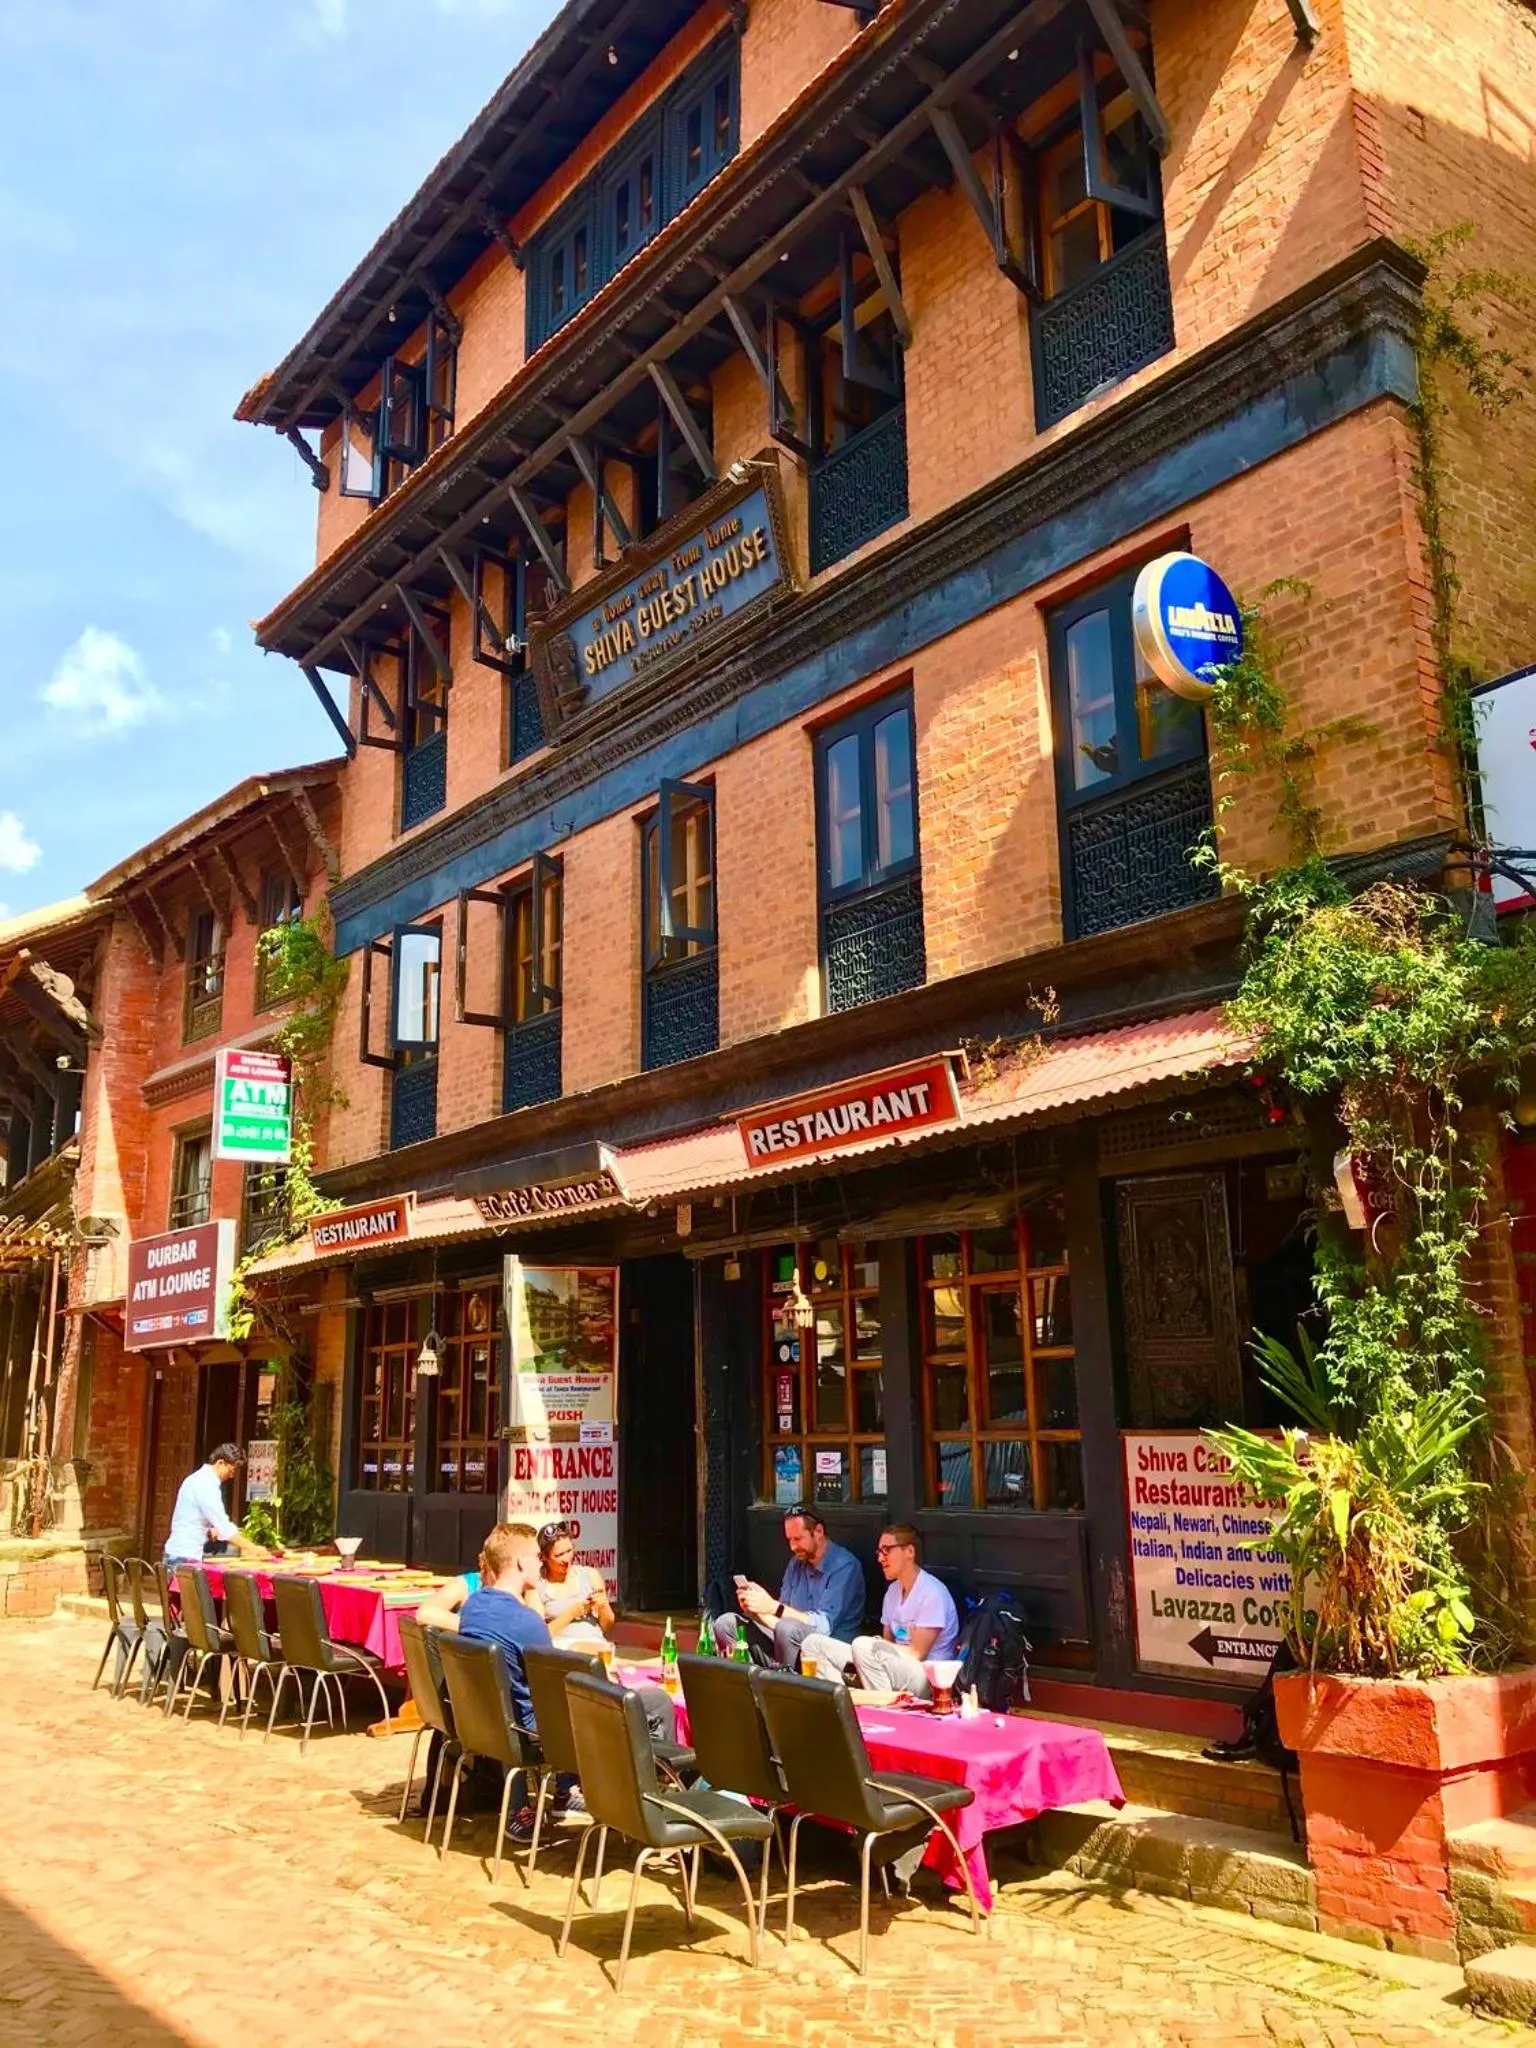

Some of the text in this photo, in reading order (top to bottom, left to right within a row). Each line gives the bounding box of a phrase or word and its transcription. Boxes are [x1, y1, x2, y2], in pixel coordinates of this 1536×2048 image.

[603, 594, 633, 623] home
[704, 517, 741, 550] home
[583, 618, 637, 674] SHIVA
[637, 575, 698, 638] GUEST
[699, 526, 767, 599] HOUSE
[230, 1079, 287, 1106] ATM
[749, 1083, 929, 1157] RESTAURANT
[532, 1182, 599, 1210] Corner
[312, 1210, 398, 1247] RESTAURANT
[147, 1239, 198, 1270] DURBAR
[133, 1267, 211, 1302] ATM LOUNGE
[547, 1410, 583, 1421] PUSH
[514, 1446, 614, 1481] ENTRANCE
[1138, 1445, 1187, 1473] Shiva
[509, 1489, 617, 1514] SHIVA GUEST HOUSE
[1135, 1476, 1246, 1509] Restaurant
[1131, 1511, 1171, 1535] Nepali,
[1174, 1512, 1220, 1537] Newari,
[571, 1549, 616, 1573] STAURANT
[1133, 1538, 1178, 1563] Italian,
[1181, 1540, 1223, 1561] Indian
[1226, 1543, 1252, 1562] and
[1176, 1567, 1292, 1592] Delicacies with
[1150, 1589, 1236, 1624] Lavazza
